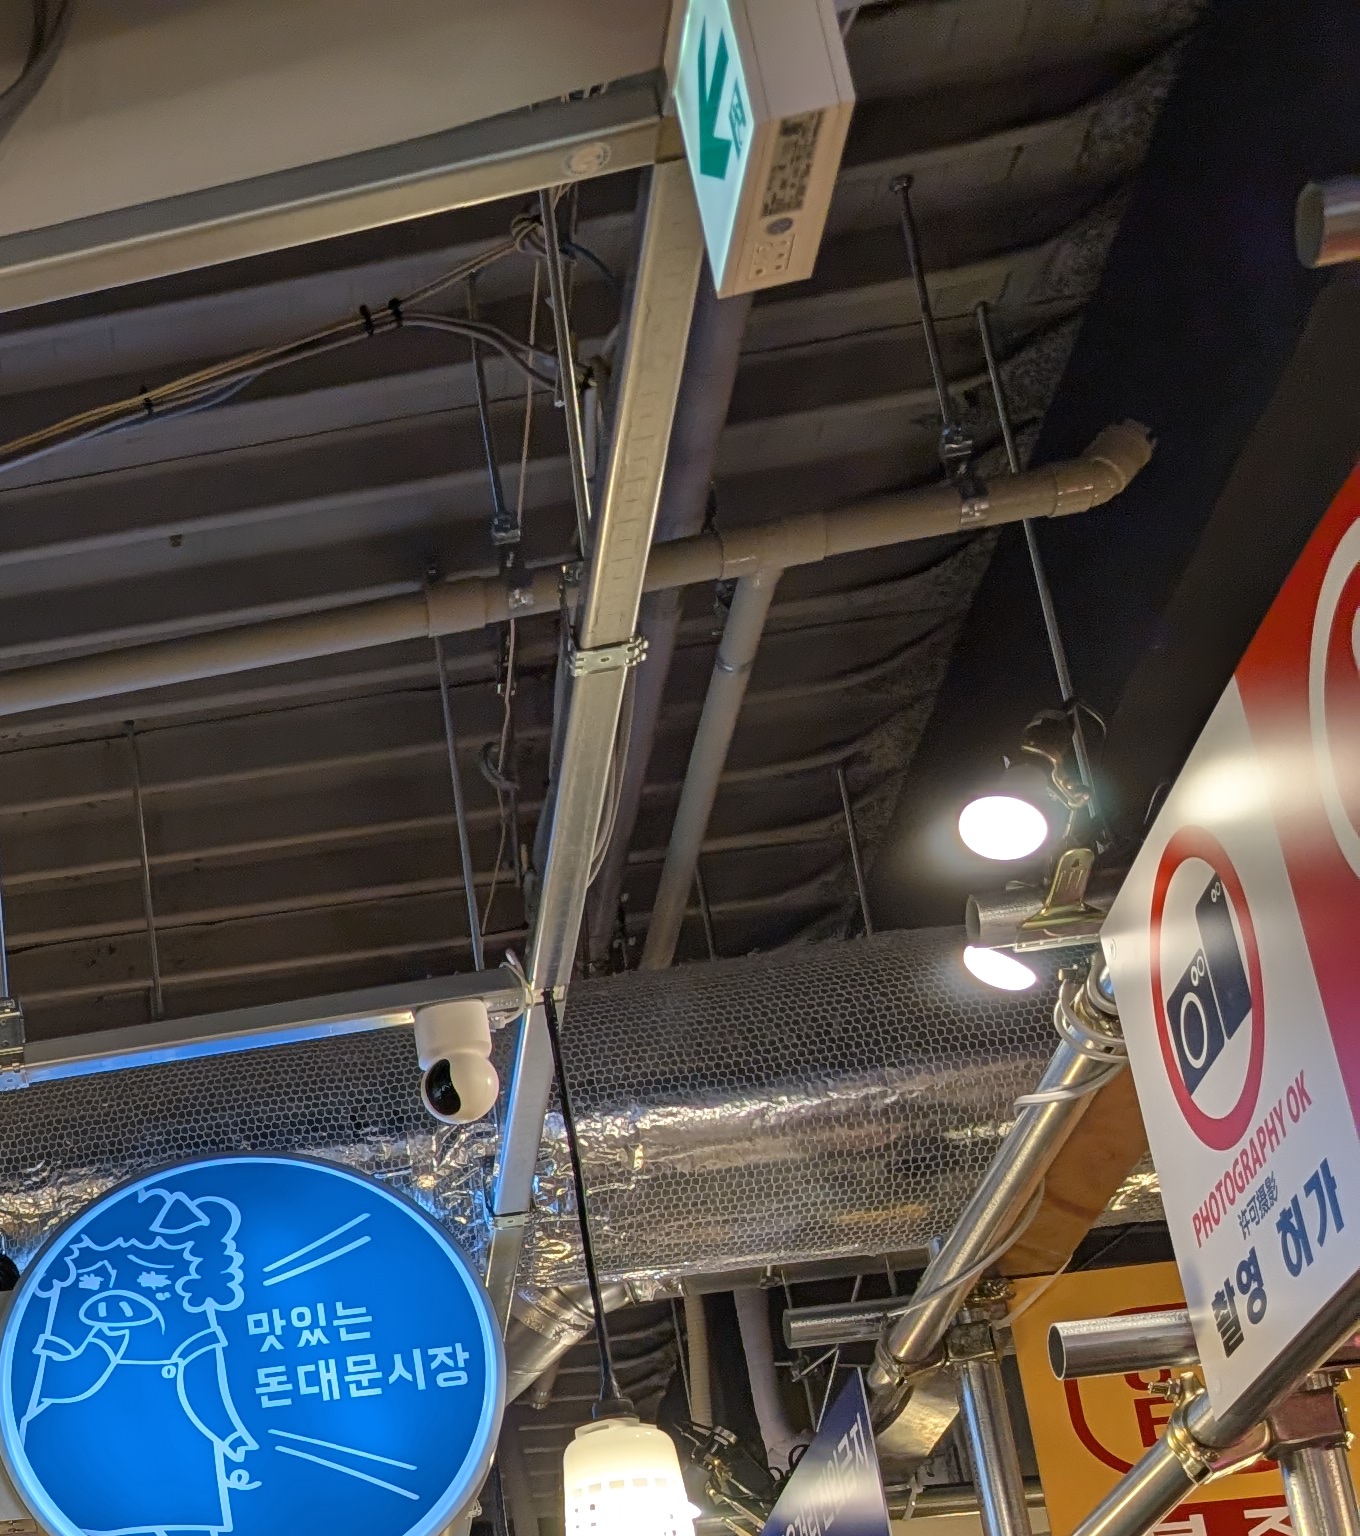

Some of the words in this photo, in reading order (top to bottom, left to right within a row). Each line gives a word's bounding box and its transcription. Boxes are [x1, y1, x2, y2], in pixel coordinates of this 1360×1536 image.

[1192, 1099, 1286, 1249] PHOTOGRAPHY
[1286, 1069, 1312, 1123] OK
[1276, 1157, 1345, 1277] 허가
[247, 1300, 373, 1354] 맛있는
[255, 1342, 470, 1409] 돈대문시장
